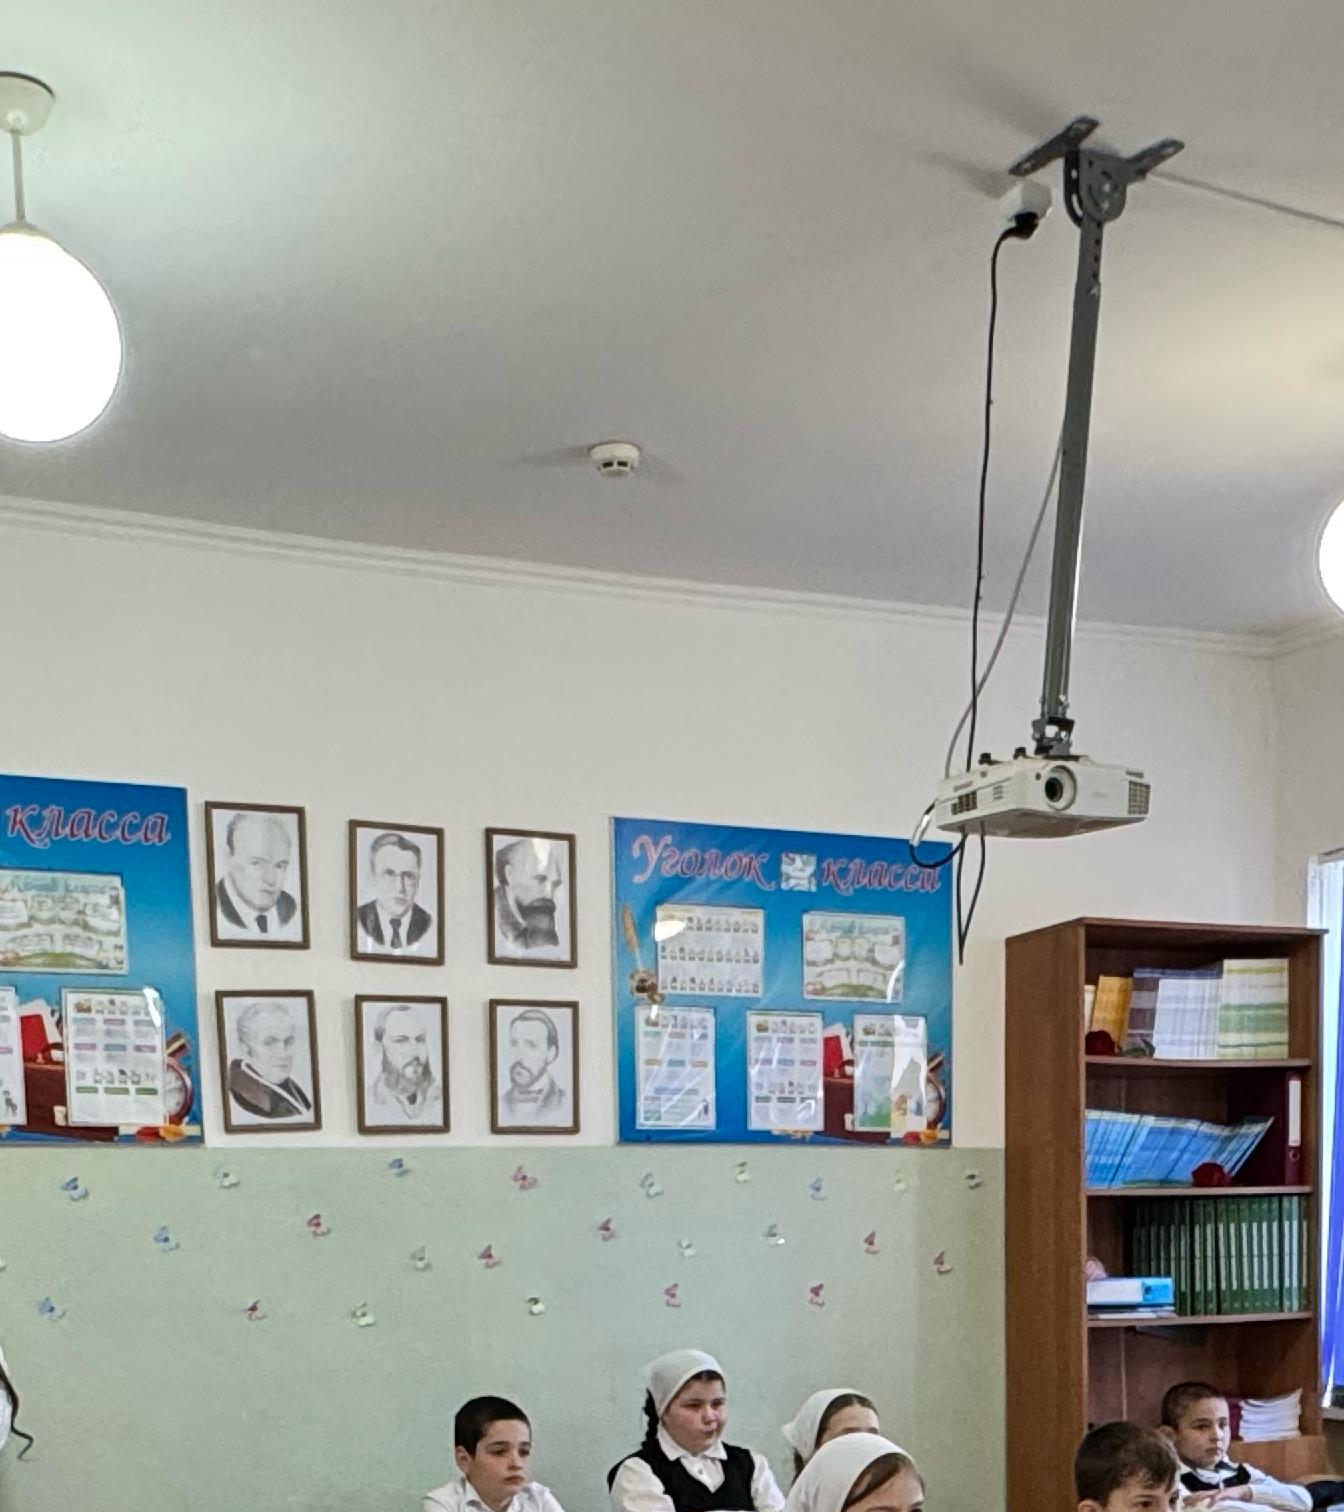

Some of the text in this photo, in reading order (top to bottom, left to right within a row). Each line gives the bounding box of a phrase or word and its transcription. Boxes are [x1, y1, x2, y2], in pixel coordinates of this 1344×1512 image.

[5, 803, 172, 848] класса
[632, 834, 942, 896] Уголок класса
